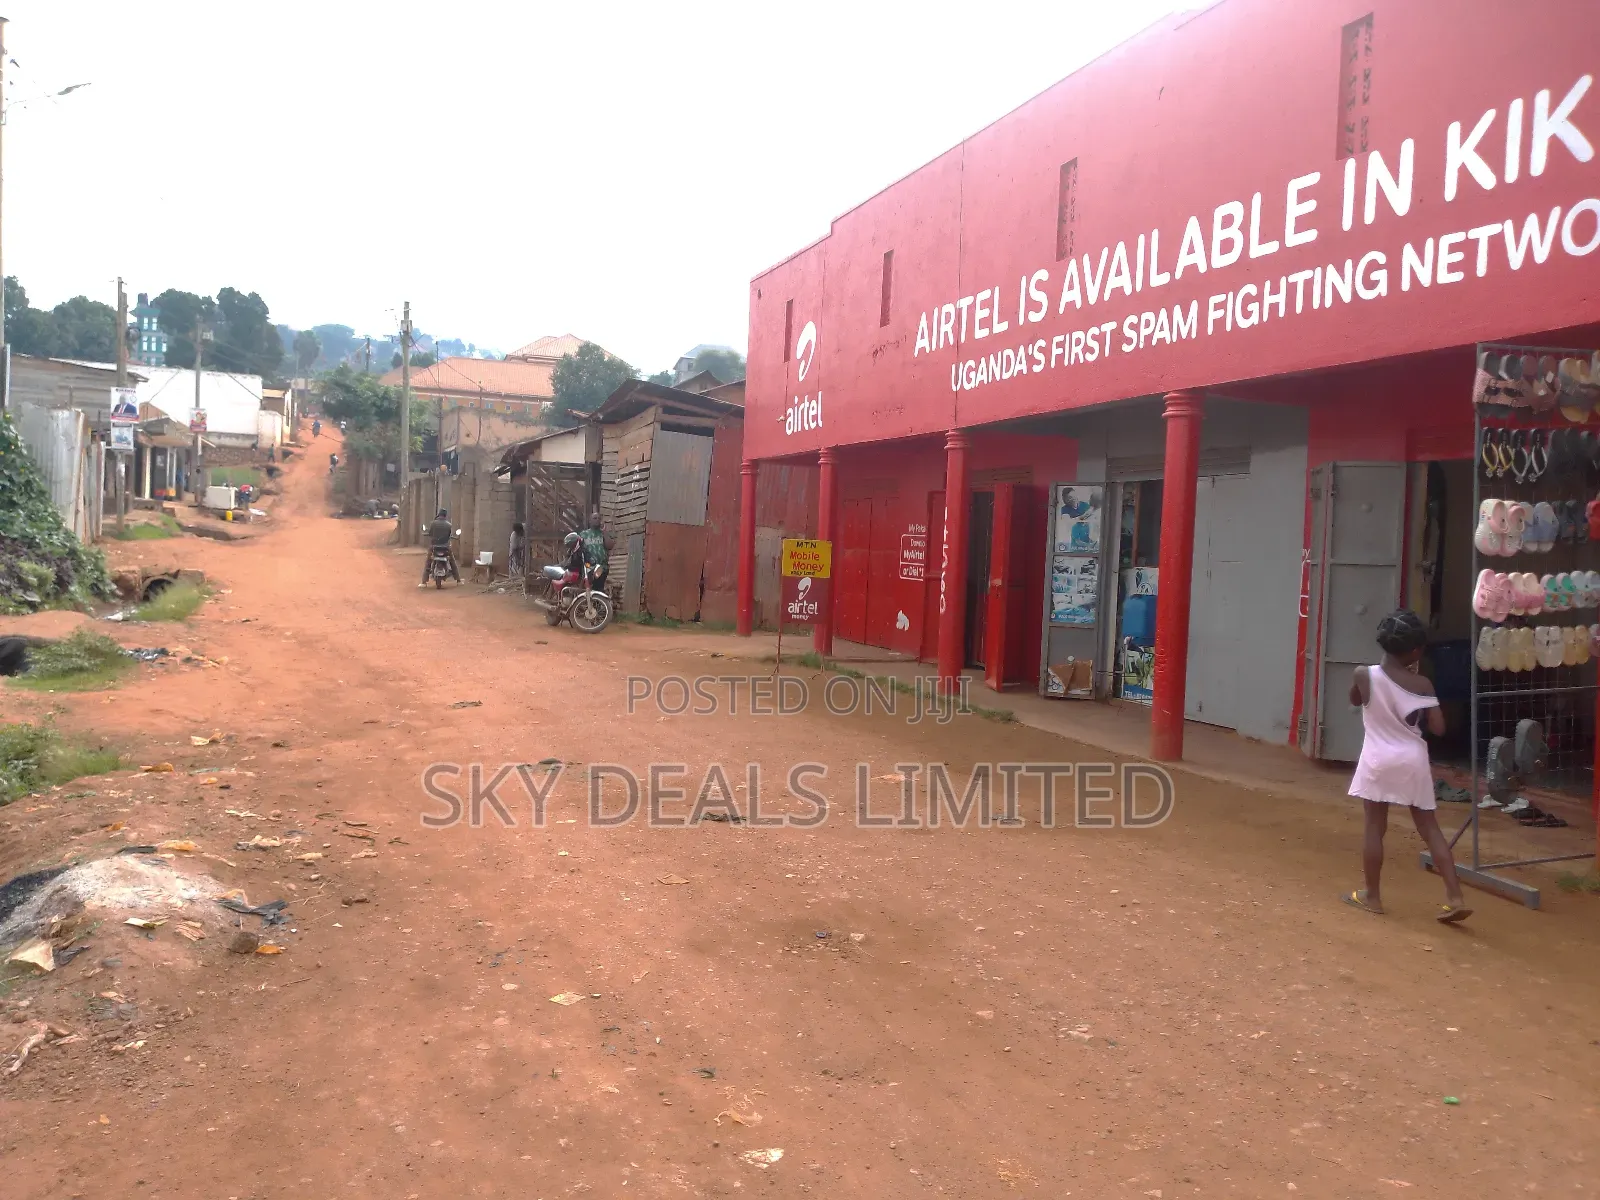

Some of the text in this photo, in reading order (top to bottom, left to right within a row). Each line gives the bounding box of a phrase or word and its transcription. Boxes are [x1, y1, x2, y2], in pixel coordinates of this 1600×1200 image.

[913, 74, 1595, 358] AIRTEL IS AVAILABLE IN KIK
[950, 197, 1600, 392] UGANDA'S FIRST SPAM FIGHTING NETWO
[784, 390, 823, 436] airtel
[796, 541, 817, 549] MTN
[790, 550, 820, 561] Mobile
[792, 561, 825, 572] Money
[787, 599, 819, 615] airtel
